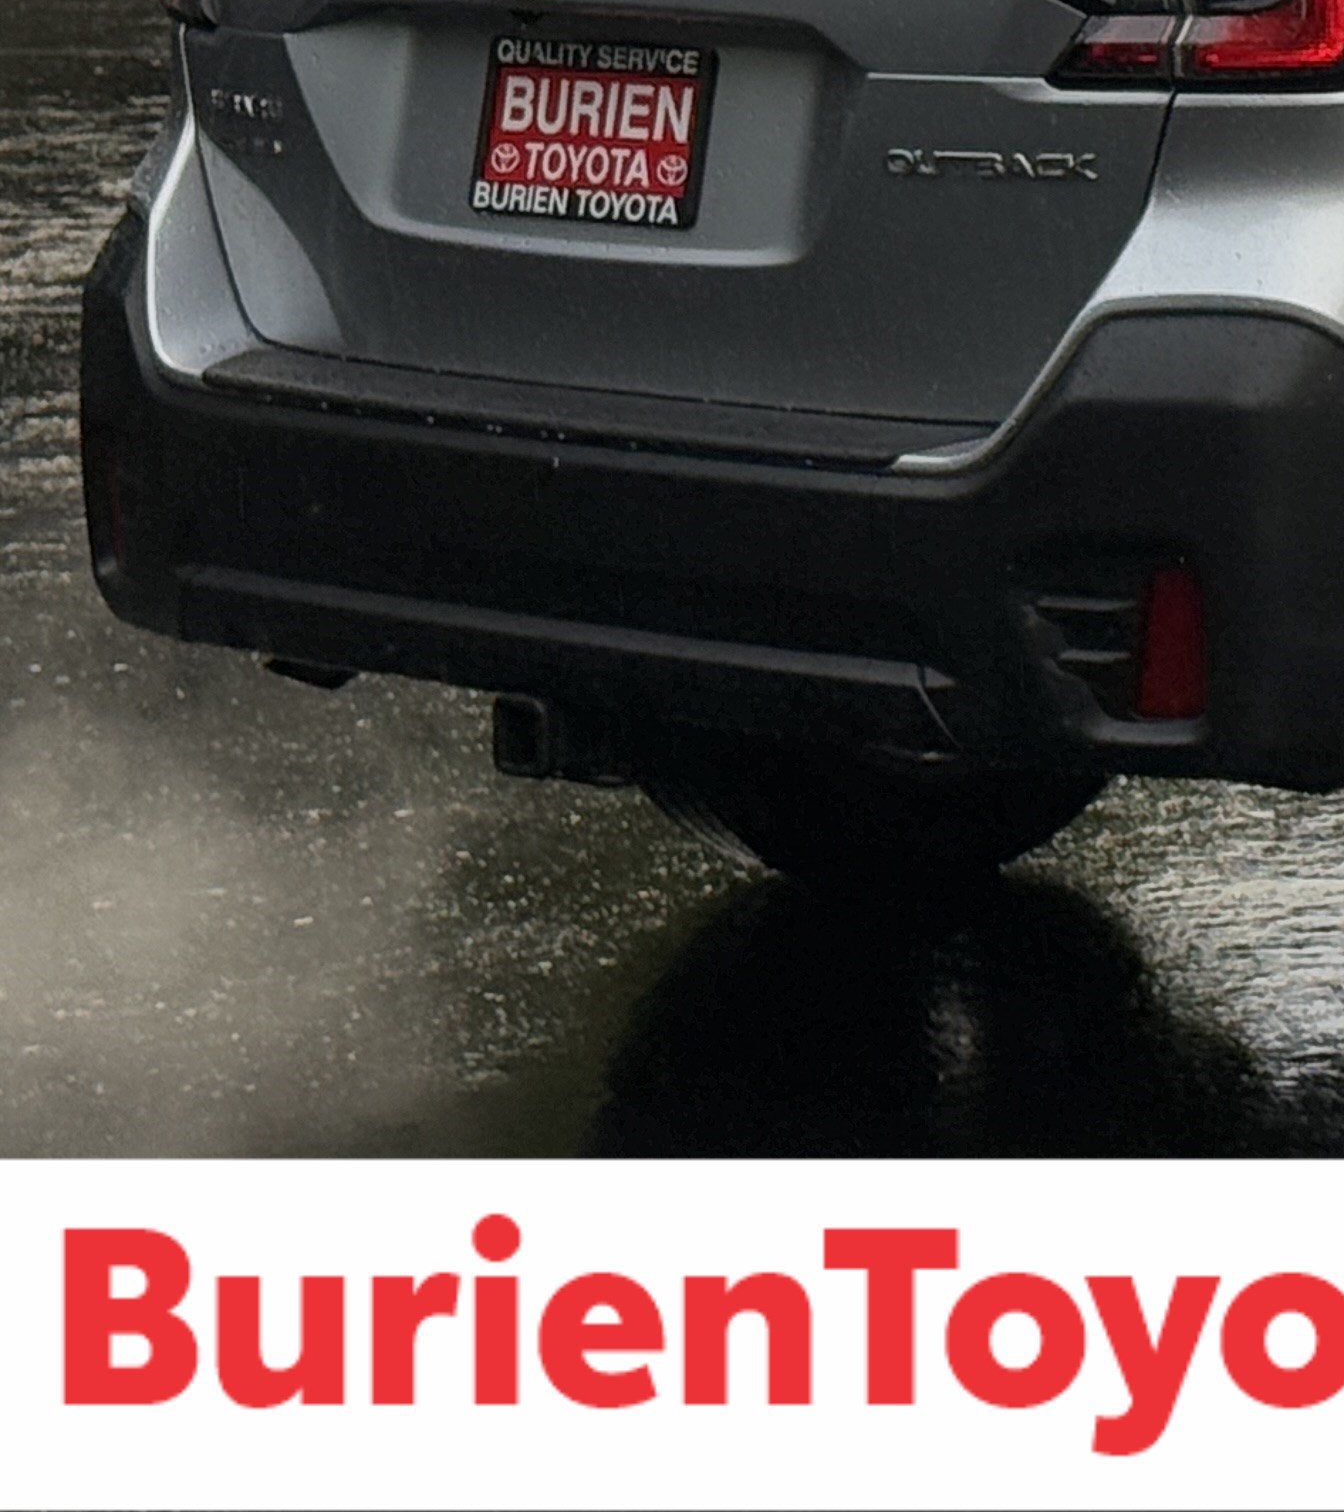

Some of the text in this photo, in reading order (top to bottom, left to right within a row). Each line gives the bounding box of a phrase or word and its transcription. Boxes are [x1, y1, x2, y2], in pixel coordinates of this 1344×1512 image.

[498, 39, 699, 75] QUALITY SERVICE
[501, 75, 695, 144] BURIEN
[524, 142, 650, 187] TOYOTA
[887, 148, 1098, 180] OUTBACK
[473, 180, 678, 225] BURIEN TOYOTA
